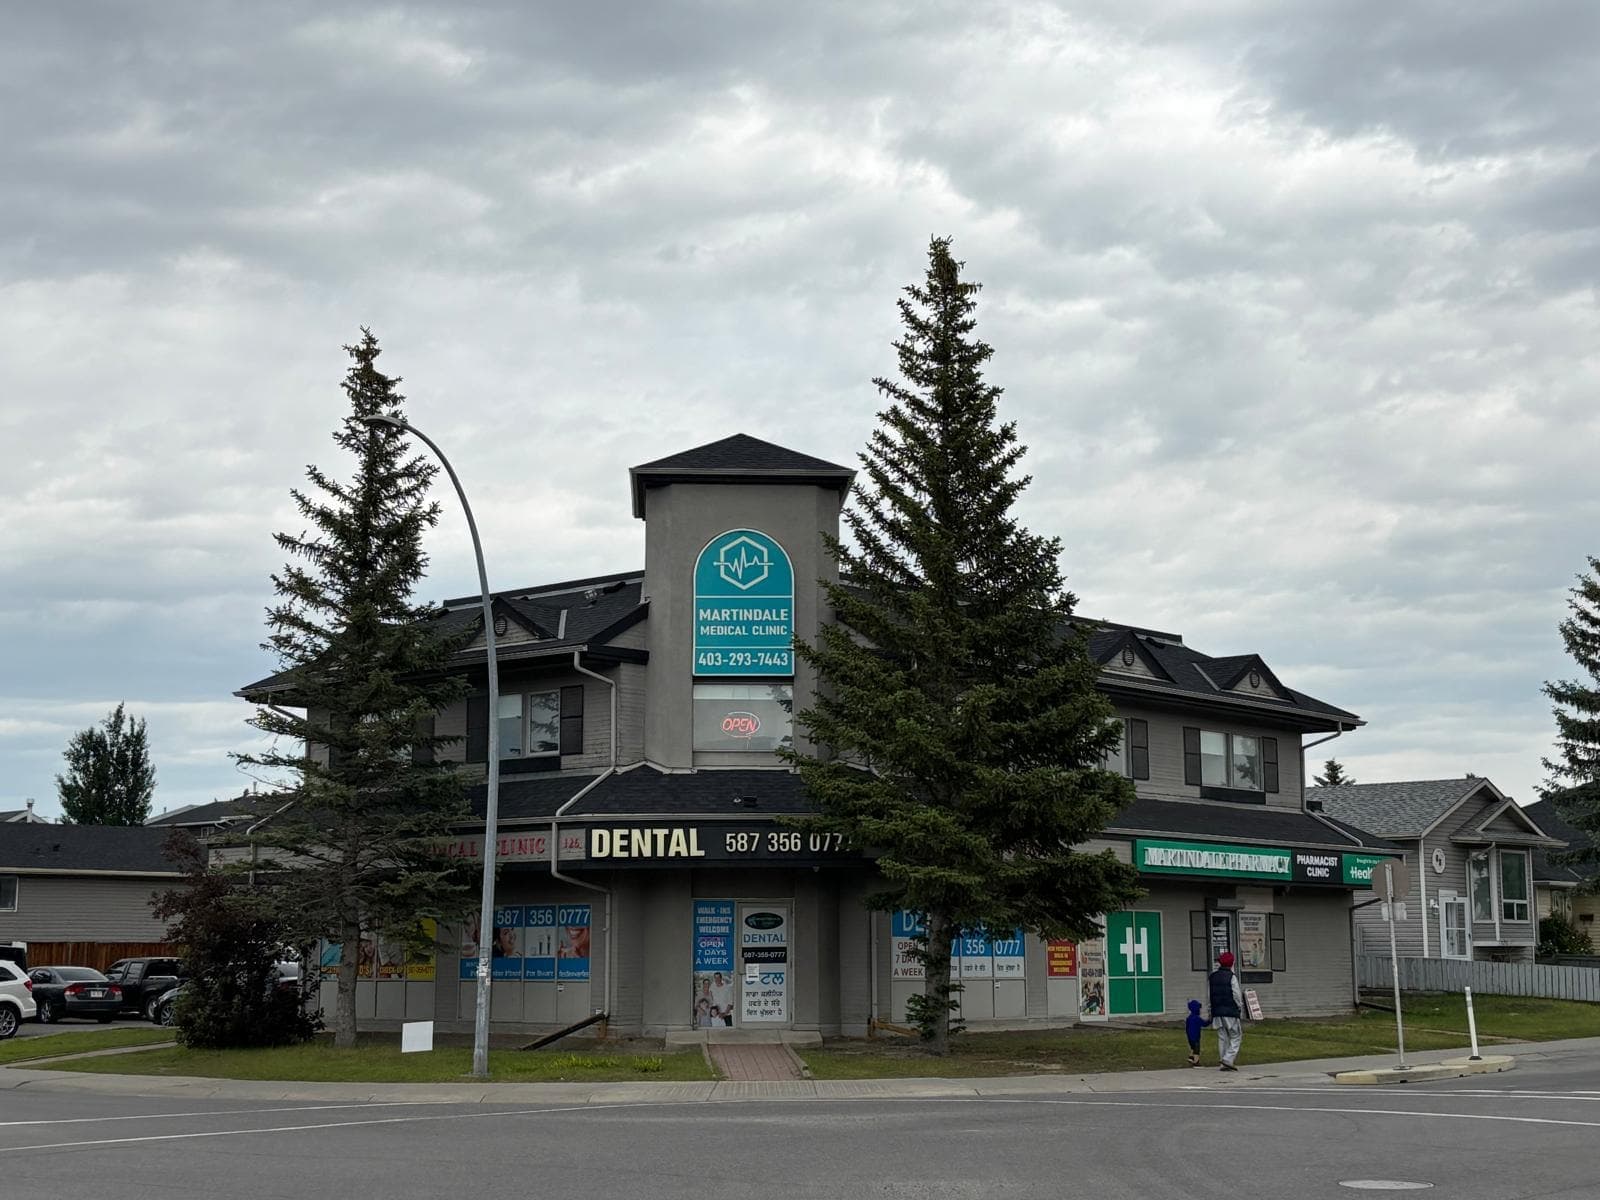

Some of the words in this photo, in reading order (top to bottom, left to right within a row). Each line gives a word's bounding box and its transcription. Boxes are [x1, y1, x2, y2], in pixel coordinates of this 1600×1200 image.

[699, 608, 789, 621] MARTINDALE
[700, 625, 748, 636] MEDICAL
[752, 625, 788, 636] CLINIC
[698, 652, 788, 666] 403-293-7443
[722, 717, 757, 732] OPEN
[591, 828, 706, 859] DENTAL
[725, 833, 761, 852] 587
[768, 832, 802, 852] 356
[1144, 847, 1227, 870] MARTINDALE
[1228, 853, 1291, 874] PHARMACY
[1296, 854, 1338, 867] PHARMACIST
[1306, 866, 1330, 878] CLINIC
[497, 909, 520, 925] 587
[529, 909, 553, 925] 356
[559, 908, 591, 925] 0777
[743, 933, 786, 943] DENTAL
[965, 940, 986, 955] 356
[995, 940, 1021, 956] 0777
[696, 957, 702, 965] A
[703, 957, 729, 965] WEEK
[895, 954, 901, 963] 7
[893, 967, 899, 977] A
[900, 967, 924, 977] WEEK
